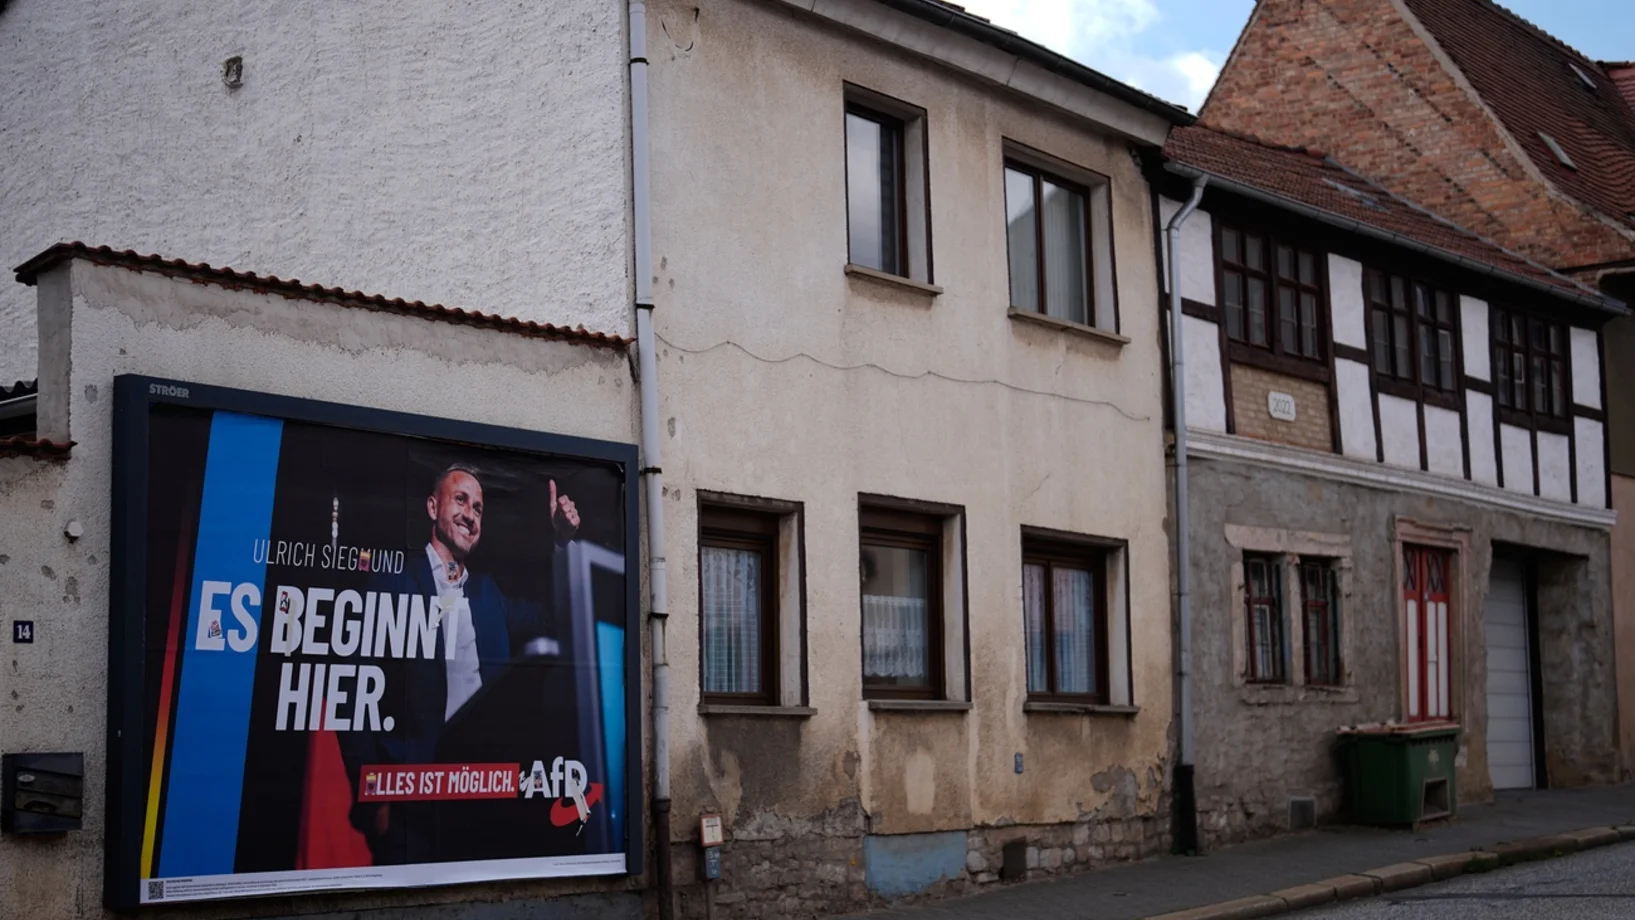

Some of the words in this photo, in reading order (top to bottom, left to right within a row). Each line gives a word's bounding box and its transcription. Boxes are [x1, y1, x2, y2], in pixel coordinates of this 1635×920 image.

[149, 383, 189, 399] STRÖER
[253, 538, 316, 567] ULRICH
[321, 544, 405, 574] SIEGUND
[17, 624, 31, 640] 14
[195, 580, 261, 652] ES
[270, 585, 469, 660] BEGINNT
[275, 662, 395, 732] HIER.
[365, 772, 415, 796] LLES
[419, 771, 444, 794] IST
[448, 766, 515, 793] MÖGLICH.
[524, 756, 588, 798] AfD
